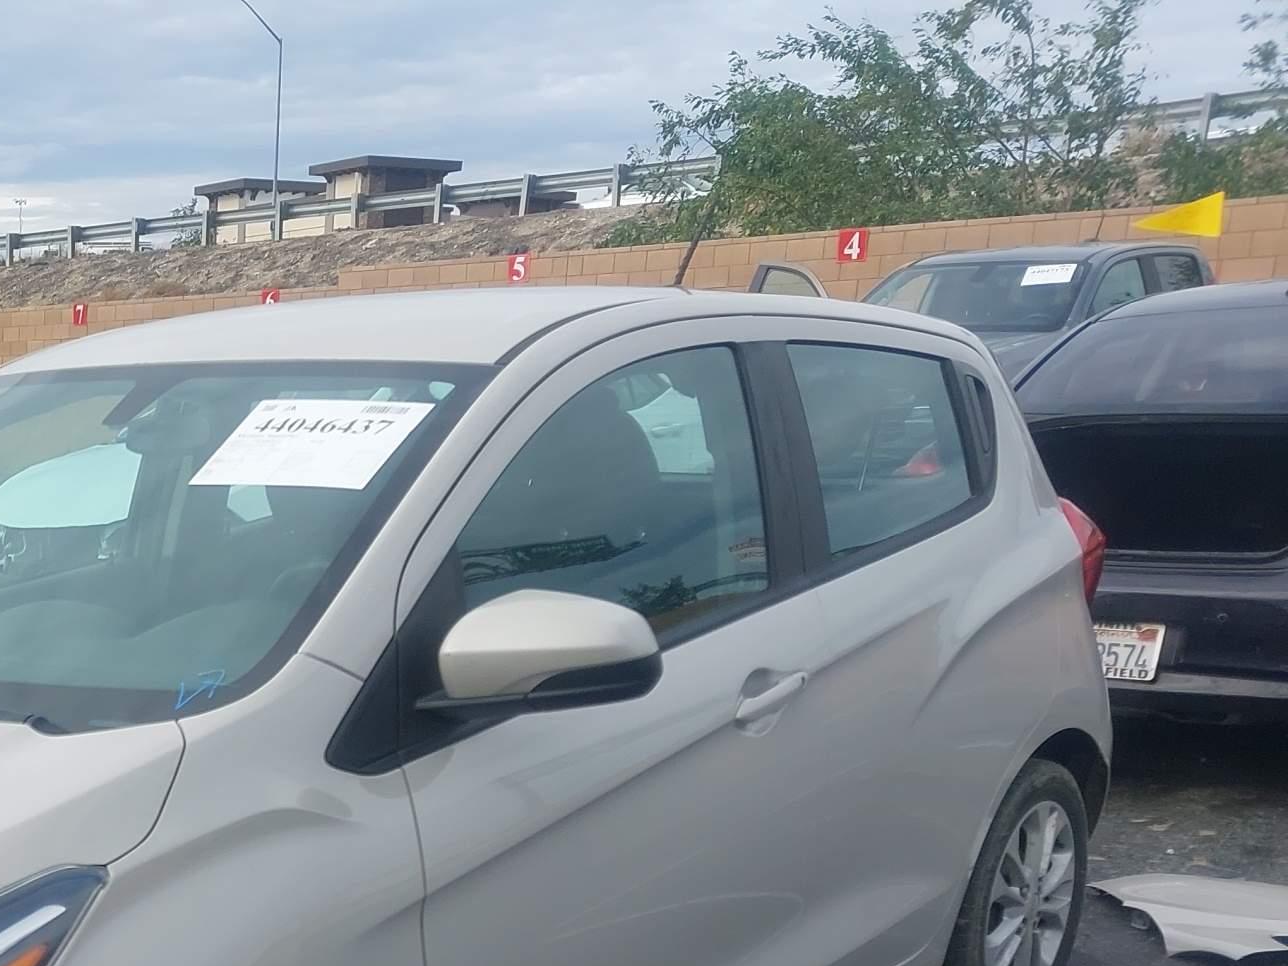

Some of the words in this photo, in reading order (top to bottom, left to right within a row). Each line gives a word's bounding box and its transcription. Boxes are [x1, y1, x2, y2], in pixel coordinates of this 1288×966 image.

[843, 231, 861, 260] 4
[511, 256, 526, 281] 5
[264, 290, 276, 304] 6
[75, 304, 85, 325] 7
[254, 416, 396, 436] 44046437
